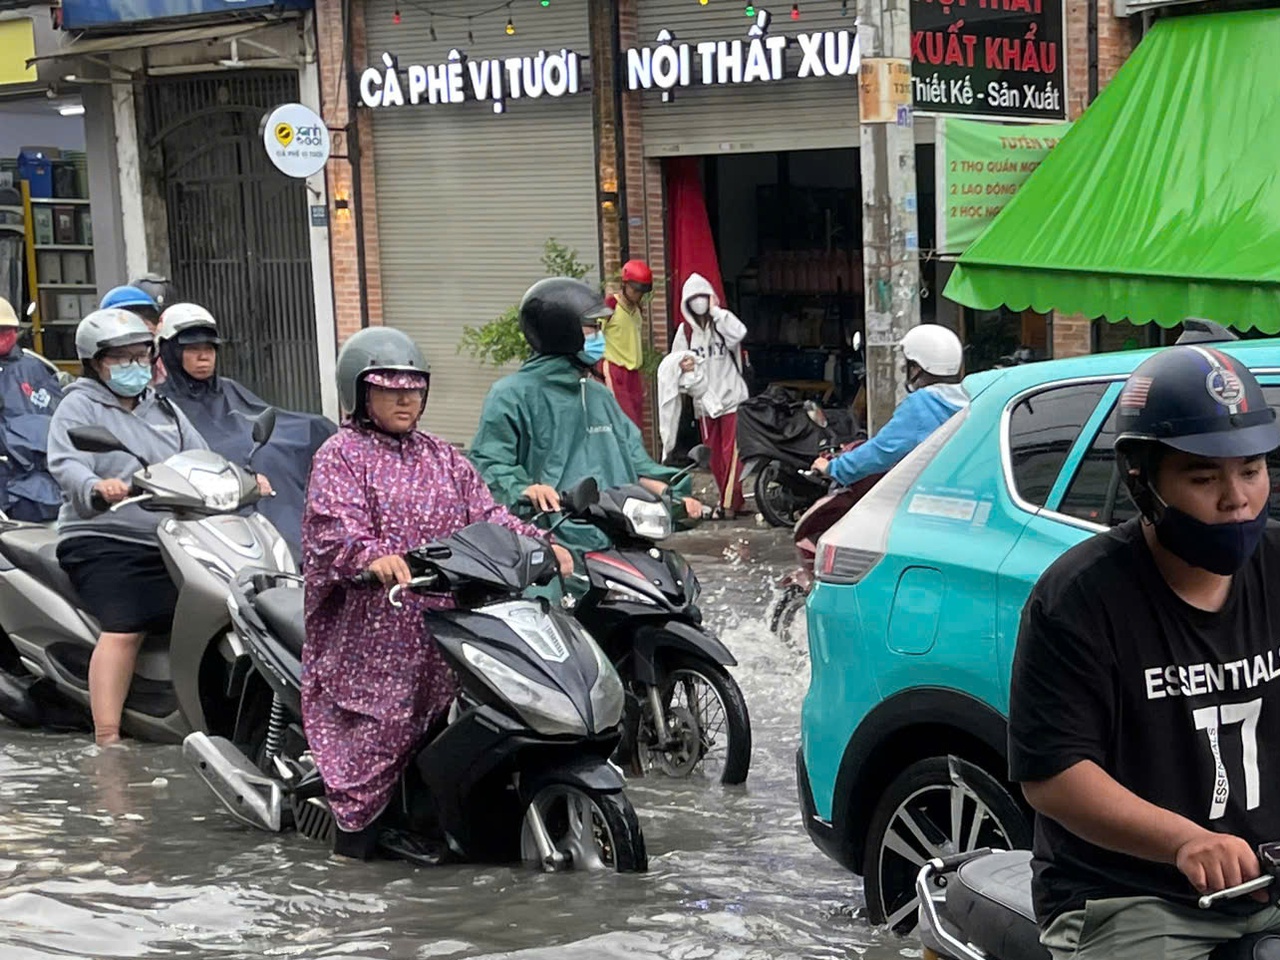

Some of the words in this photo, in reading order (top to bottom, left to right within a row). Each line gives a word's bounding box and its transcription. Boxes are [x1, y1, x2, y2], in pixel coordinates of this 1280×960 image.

[627, 28, 691, 103] NỘI
[911, 19, 977, 68] XUẤT
[985, 22, 1057, 74] KHẨU
[359, 52, 405, 108] CÀ
[408, 48, 465, 105] PHÊ
[468, 59, 503, 114] VỊ
[505, 48, 579, 99] TƯƠI
[911, 73, 947, 104] hiết
[950, 75, 974, 105] Kế
[988, 81, 1020, 109] Sản
[1023, 81, 1061, 111] Xuất
[951, 161, 958, 172] 2
[951, 184, 958, 195] 2
[951, 207, 957, 218] 2
